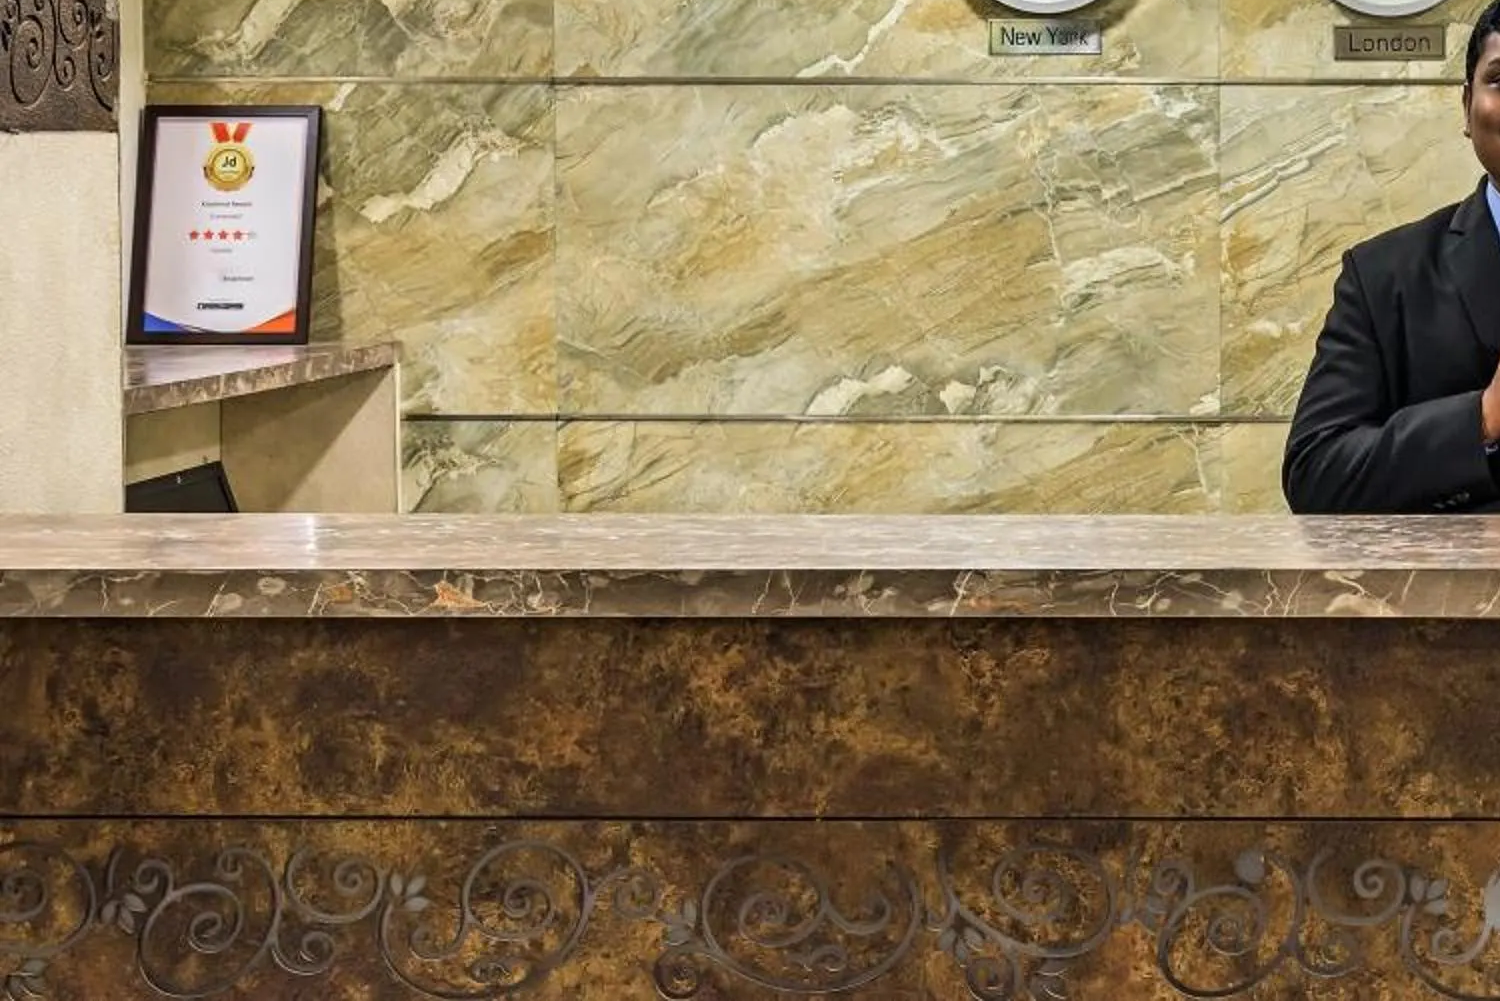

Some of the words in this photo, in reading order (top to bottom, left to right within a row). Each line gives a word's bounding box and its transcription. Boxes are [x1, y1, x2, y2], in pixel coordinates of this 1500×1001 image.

[1000, 26, 1041, 46] New
[1046, 26, 1089, 46] York
[1349, 32, 1431, 52] London
